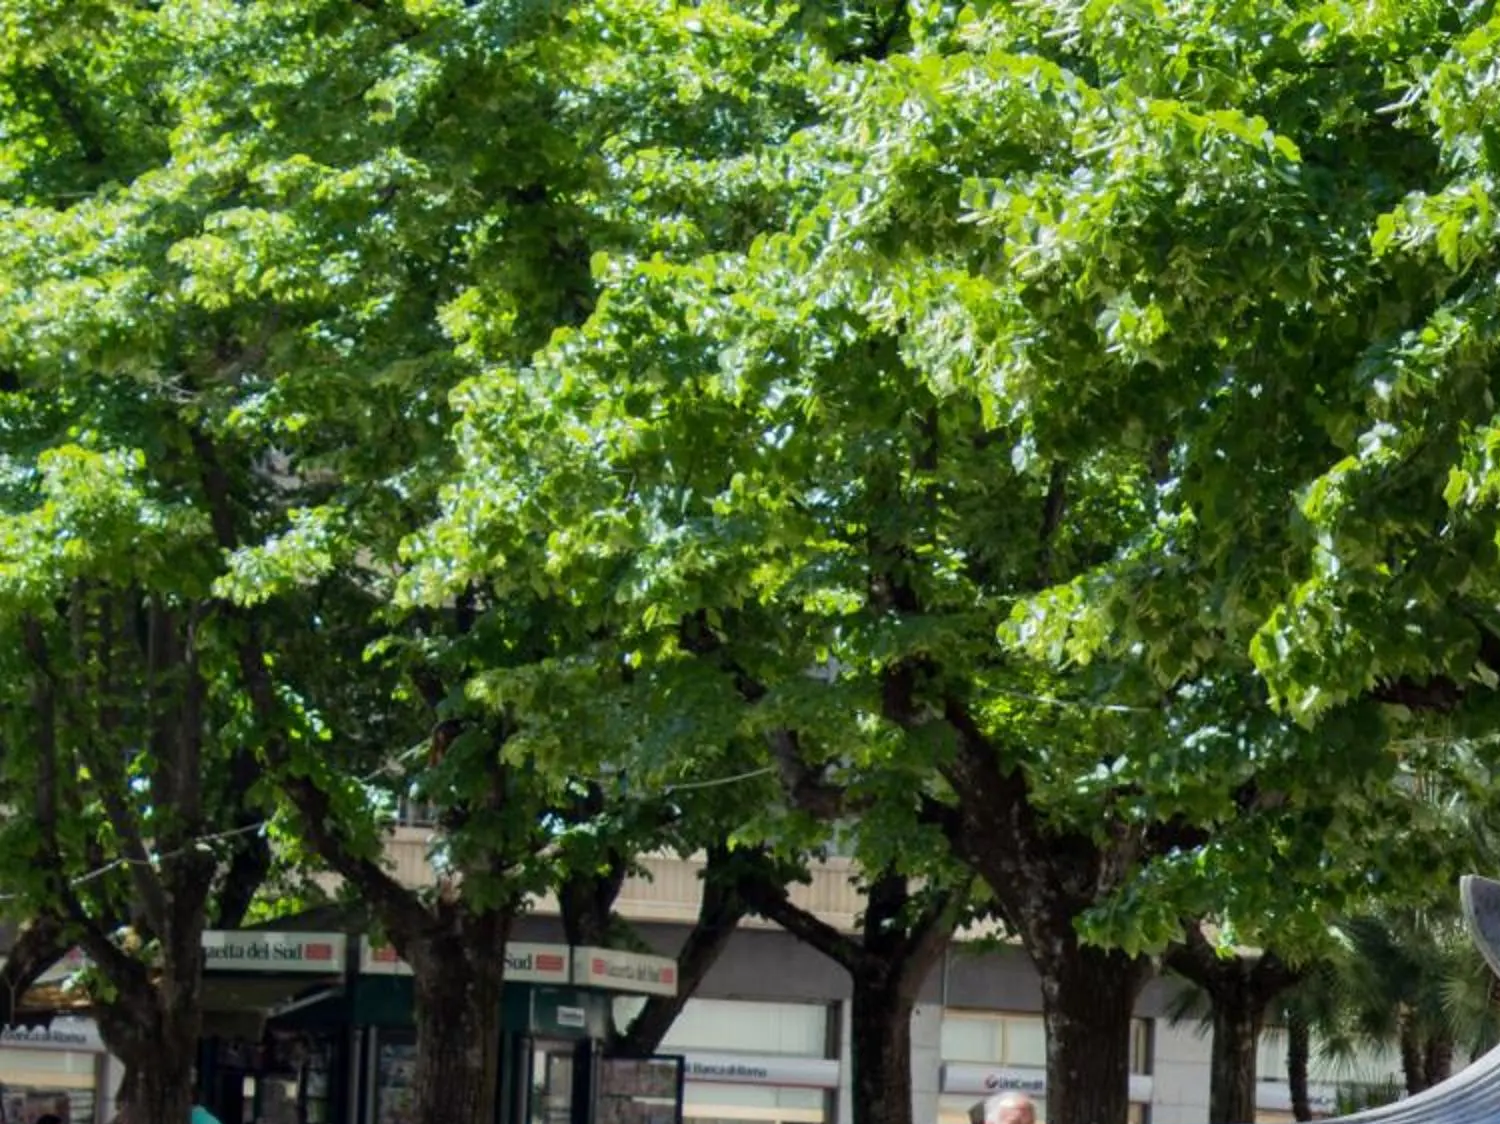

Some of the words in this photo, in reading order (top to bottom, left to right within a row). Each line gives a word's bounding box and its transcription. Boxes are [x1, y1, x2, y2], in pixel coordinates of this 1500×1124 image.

[247, 942, 269, 960] del
[273, 943, 302, 960] Sud
[503, 953, 532, 970] Sud
